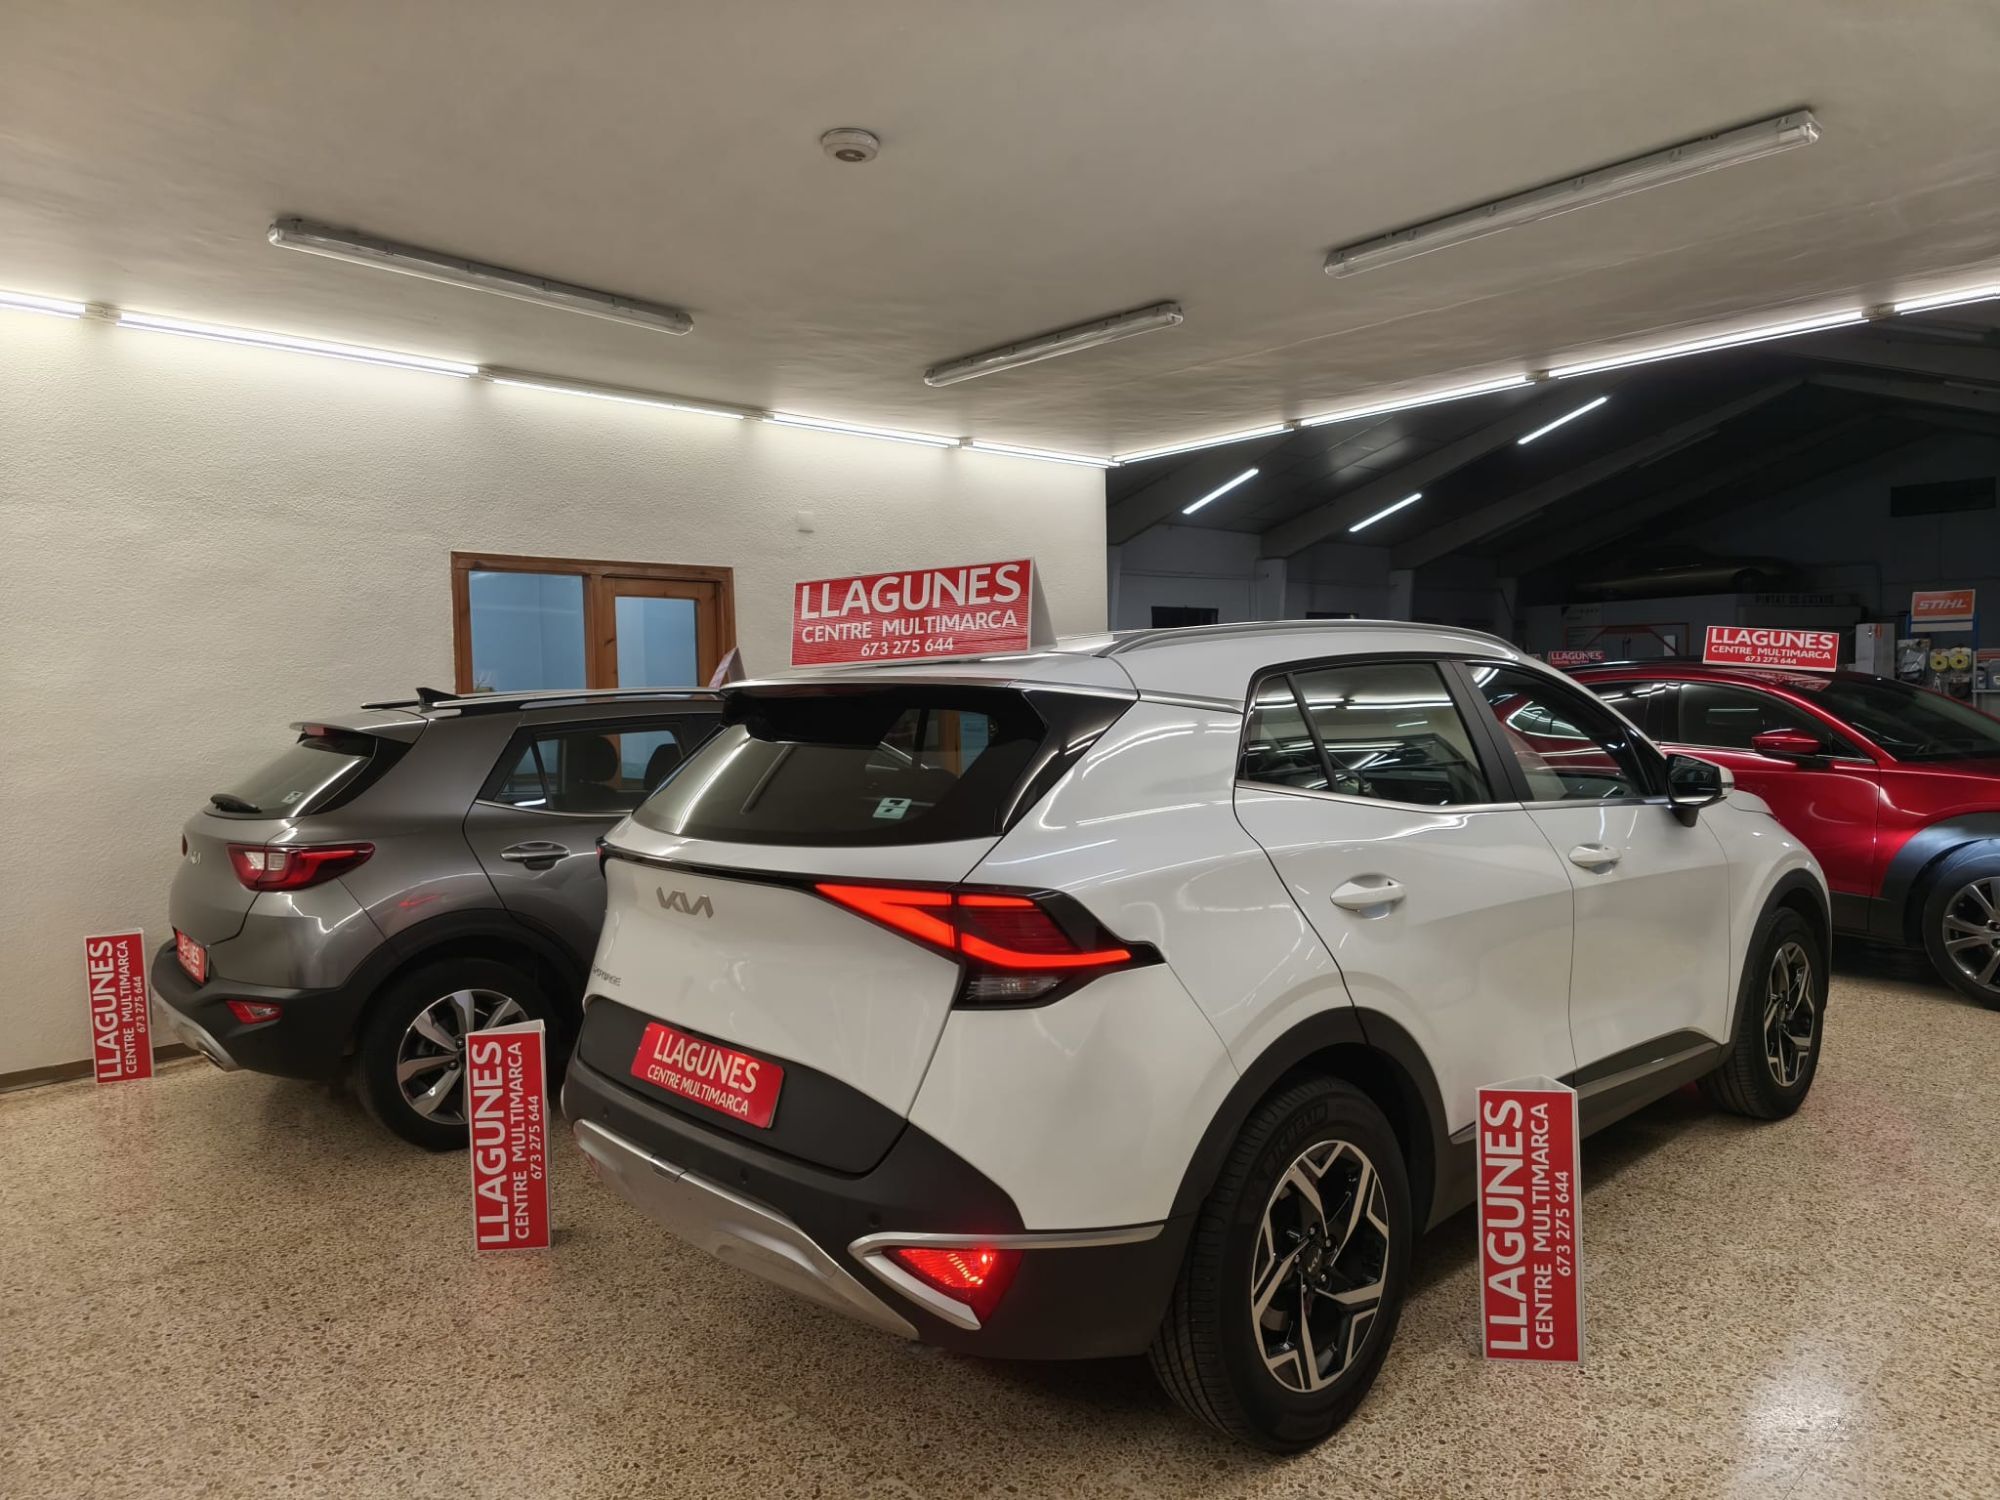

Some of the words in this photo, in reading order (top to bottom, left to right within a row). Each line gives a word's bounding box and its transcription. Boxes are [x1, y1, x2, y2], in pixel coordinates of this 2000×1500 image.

[801, 564, 1022, 620] LLAGUNES
[1918, 599, 1967, 610] STIHL
[802, 621, 872, 643] CENTRE
[882, 609, 1018, 637] MULTIMARCA
[1711, 628, 1834, 650] LLAGUNES
[861, 642, 888, 656] 673
[893, 639, 920, 654] 275
[924, 637, 954, 652] 644
[1551, 650, 1603, 660] LLAGUNES
[1711, 645, 1752, 655] CENTRE
[1757, 648, 1831, 659] MULTIMARCA
[116, 940, 133, 1022] MULTIMARCA
[133, 976, 144, 993] 644
[89, 940, 122, 1078] LLAGUNES
[135, 996, 145, 1014] 275
[136, 1016, 146, 1033] 673
[123, 1028, 138, 1074] CENTRE
[653, 1031, 760, 1094] LLAGUNES
[507, 1042, 527, 1162] MULTIMARCA
[647, 1064, 680, 1088] CENTRE
[682, 1076, 749, 1116] MULTIMARCA
[528, 1095, 540, 1121] 644
[471, 1041, 510, 1243] LLAGUNES
[529, 1125, 541, 1150] 275
[531, 1154, 542, 1180] 673
[1530, 1103, 1552, 1252] MULTIMARCA
[1554, 1171, 1569, 1203] 644
[513, 1170, 530, 1239] CENTRE
[1484, 1099, 1528, 1350] LLAGUNES
[1555, 1208, 1570, 1239] 275
[1556, 1244, 1571, 1277] 673
[1534, 1263, 1553, 1349] CENTRE
